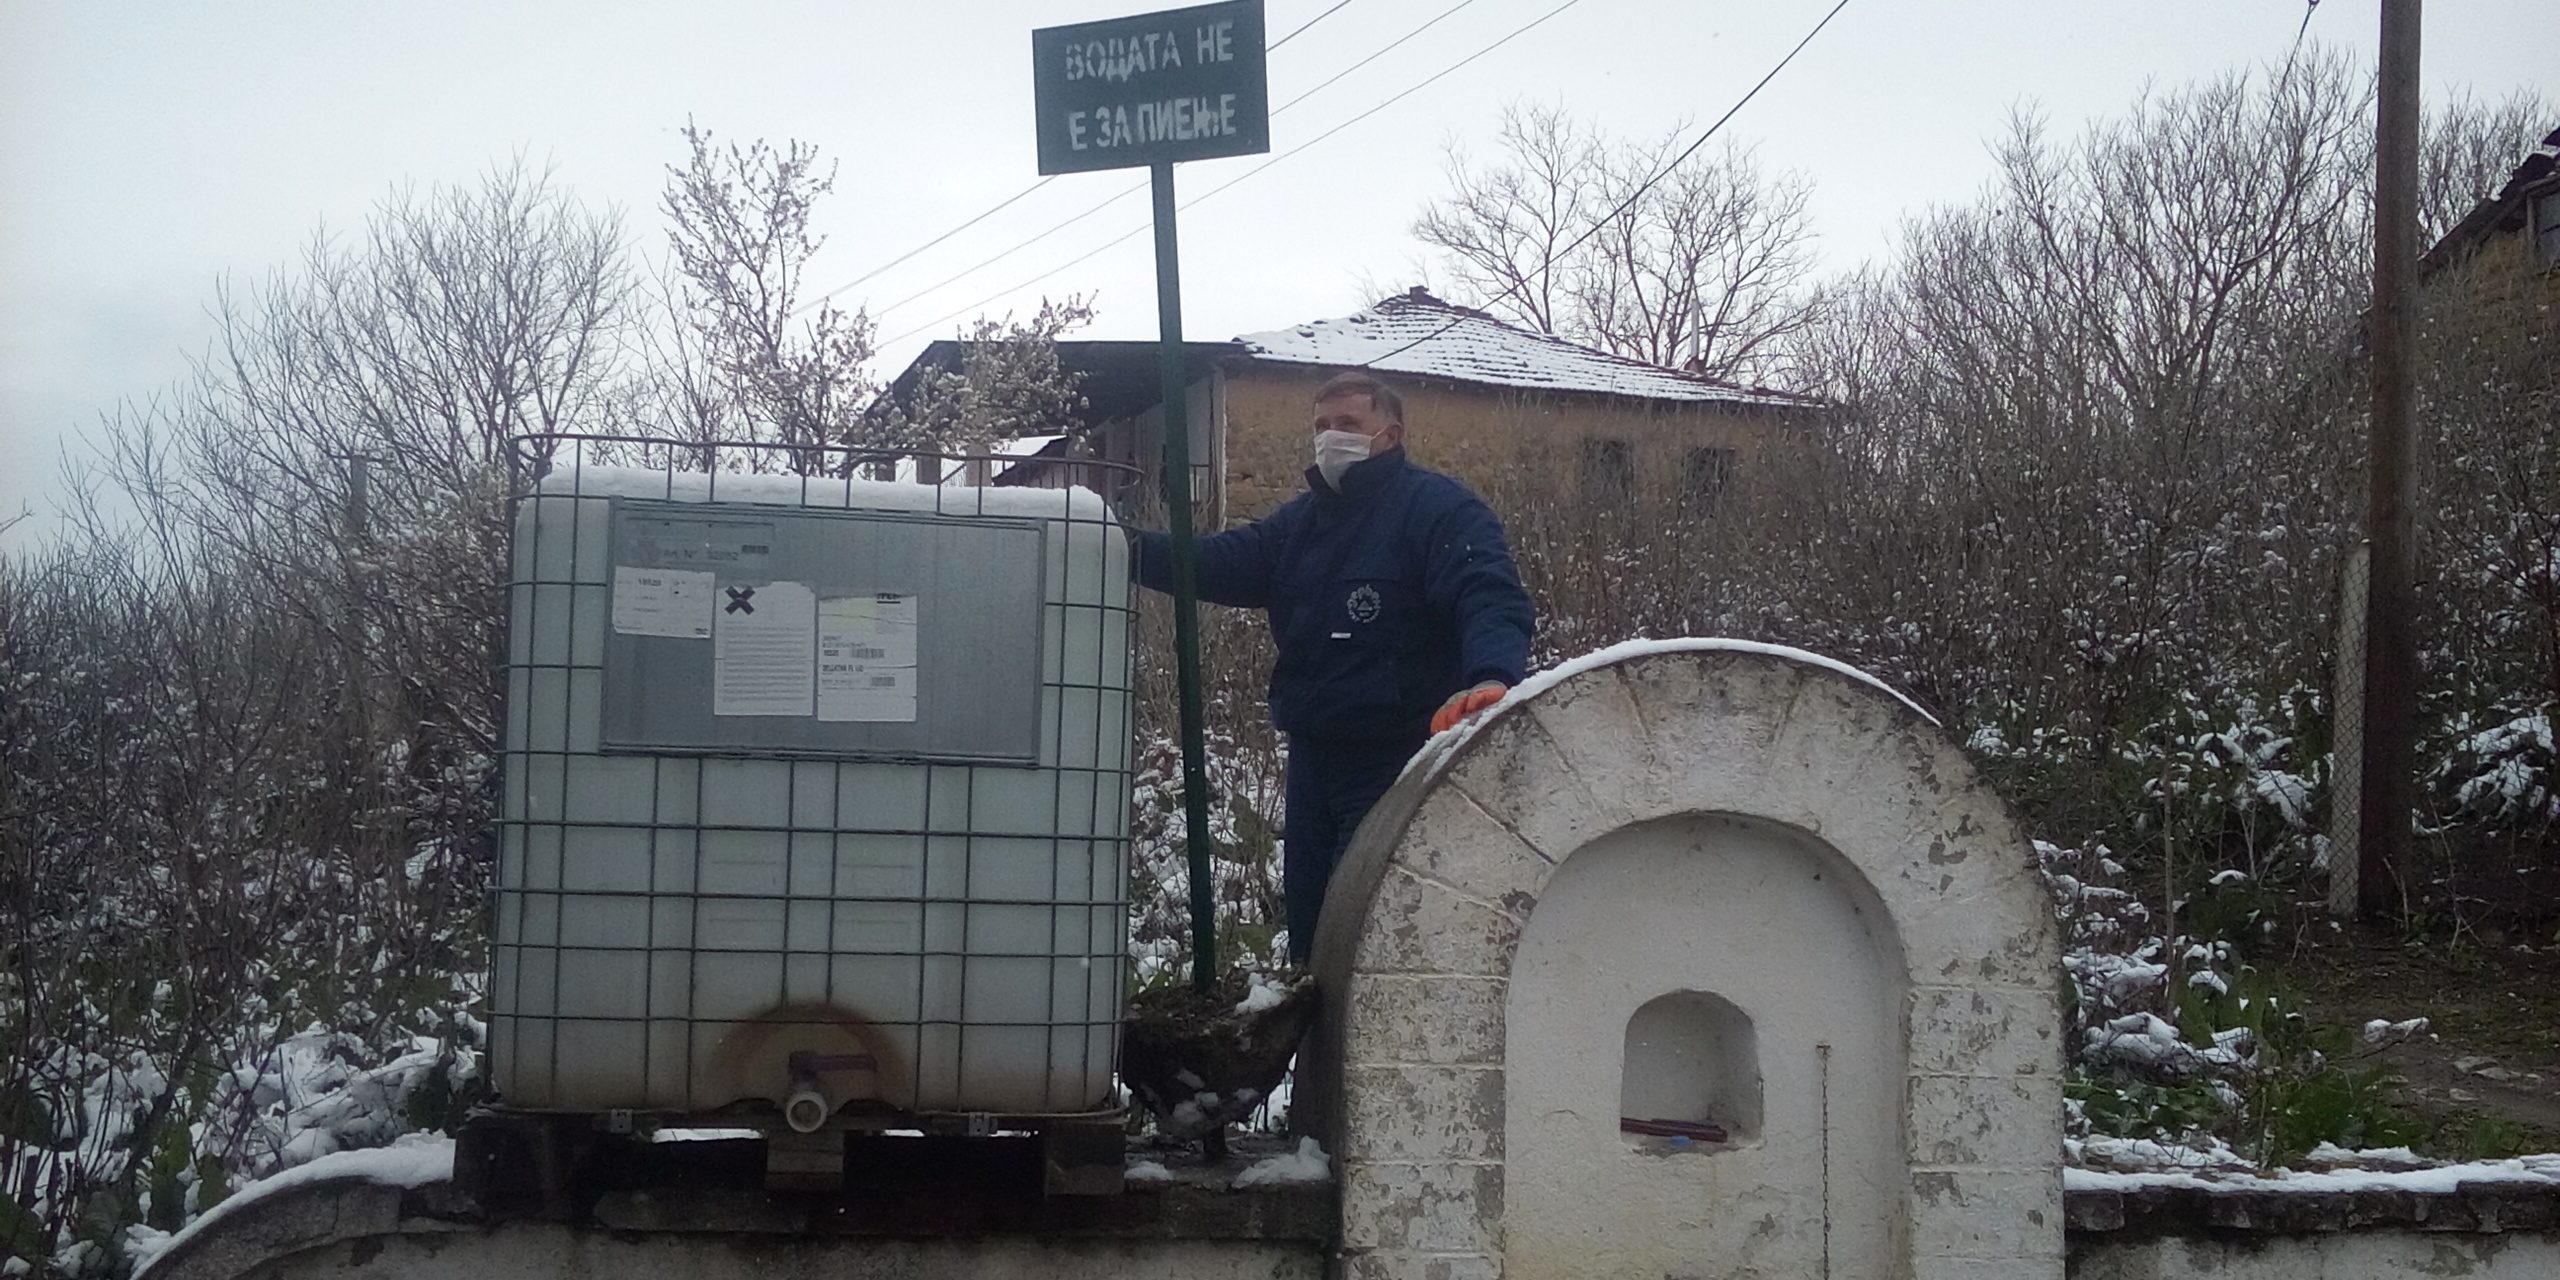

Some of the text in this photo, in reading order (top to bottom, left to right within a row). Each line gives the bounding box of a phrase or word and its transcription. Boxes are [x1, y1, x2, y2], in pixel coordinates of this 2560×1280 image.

[1065, 21, 1234, 82] ВОДАТА НЕ
[1068, 94, 1237, 151] Е ЗА ПИЕЊЕ
